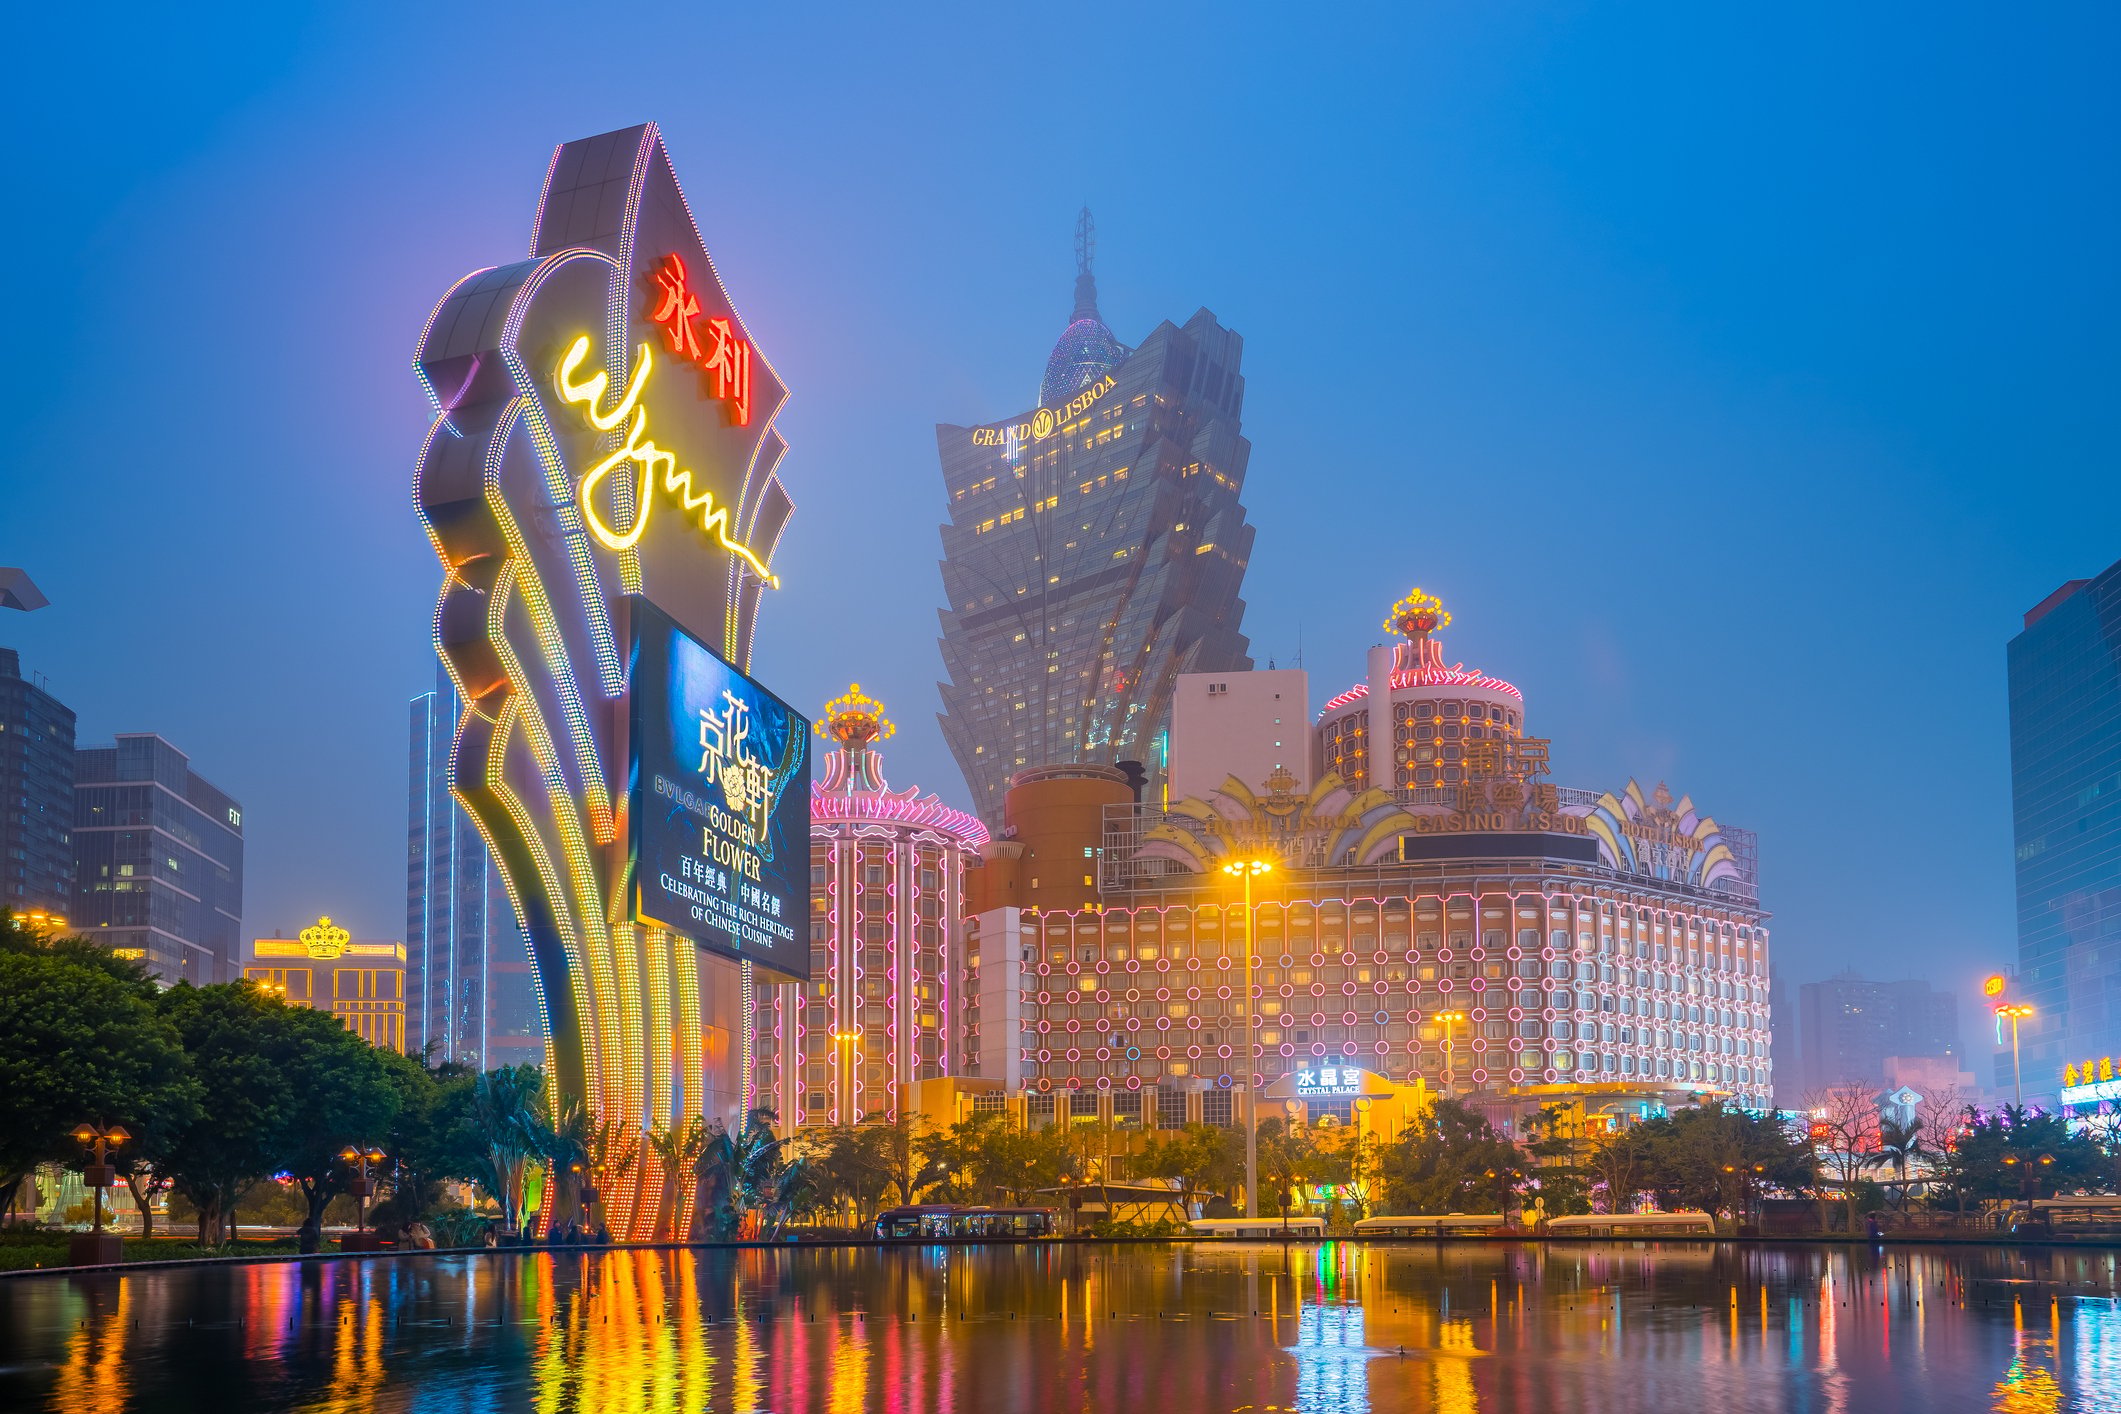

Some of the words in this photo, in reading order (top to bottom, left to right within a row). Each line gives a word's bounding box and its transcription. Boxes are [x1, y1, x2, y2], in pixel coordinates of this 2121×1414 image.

[655, 253, 751, 427] 永利
[972, 423, 1032, 446] GRAND
[1055, 374, 1118, 427] LISBOA
[1464, 735, 1552, 776] 葡京
[229, 807, 241, 827] FIT
[710, 804, 756, 848] GOLDEN
[1204, 816, 1274, 836] HOTEL
[1285, 814, 1364, 833] LISBOA
[1415, 812, 1505, 833] CASINO
[1515, 813, 1590, 836] LISBOA
[1620, 820, 1661, 843] HOTEL
[1665, 830, 1705, 853] LISBOA
[681, 854, 727, 895] 百年經典
[702, 826, 762, 883] FLOWER
[660, 873, 720, 911] CELEBRATING
[720, 899, 738, 920] THE
[739, 907, 758, 928] RICH
[760, 916, 794, 941] HERITAGE
[691, 905, 704, 921] OF
[705, 908, 741, 936] CHINESE
[742, 924, 773, 949] CUISINE
[1297, 1068, 1360, 1087] 水晶宮
[1297, 1086, 1331, 1095] CRYSTAL
[1332, 1085, 1360, 1094] PALACE
